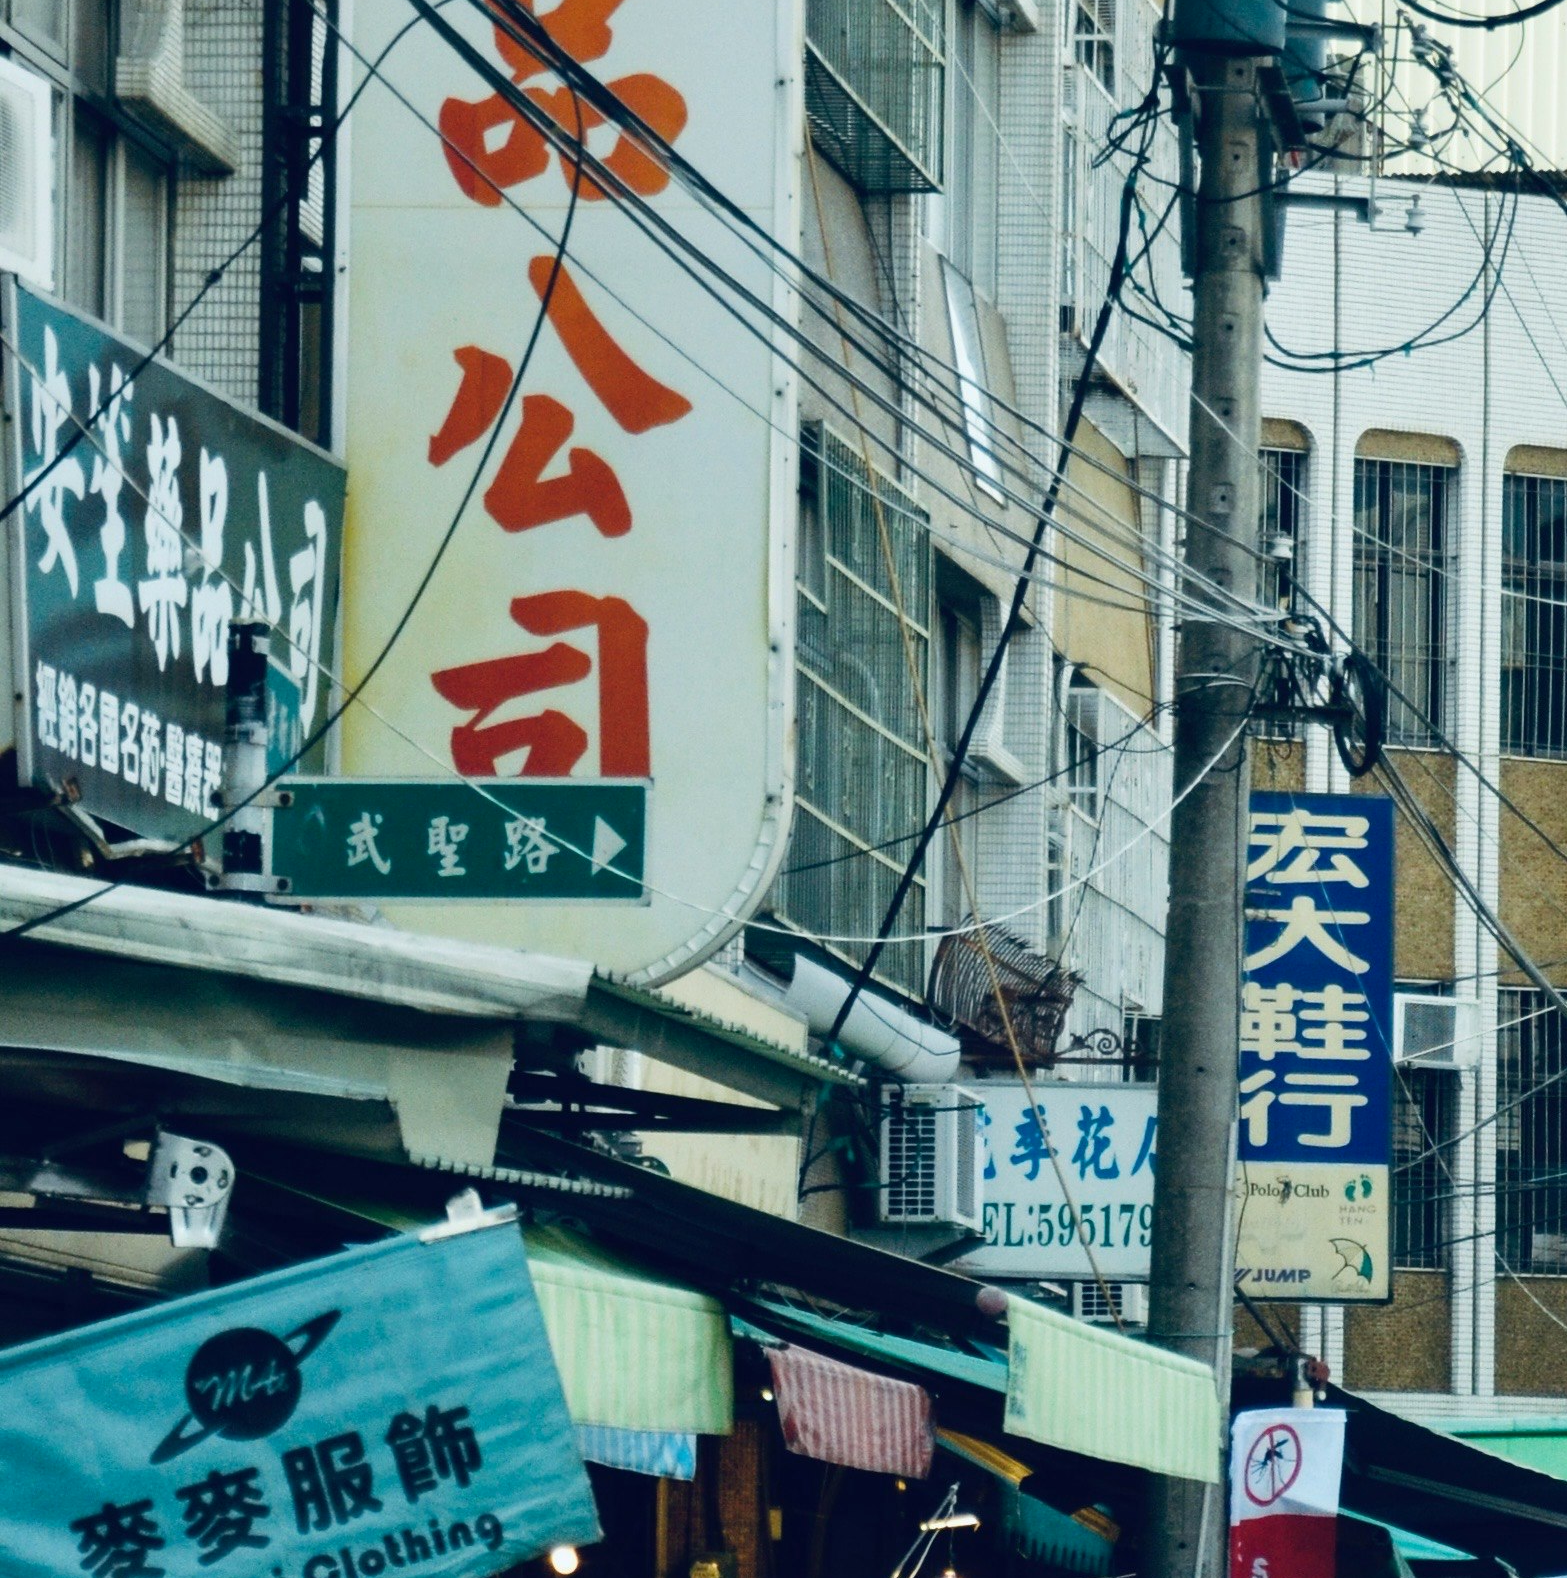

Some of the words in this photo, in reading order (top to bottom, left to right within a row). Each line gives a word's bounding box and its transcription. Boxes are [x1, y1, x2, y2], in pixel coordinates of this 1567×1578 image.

[345, 813, 562, 880] 武聖路
[1240, 809, 1370, 1148] 宏大鞋行
[1250, 1182, 1280, 1198] Polo
[1294, 1182, 1330, 1198] Club
[1251, 1268, 1312, 1284] JUMP
